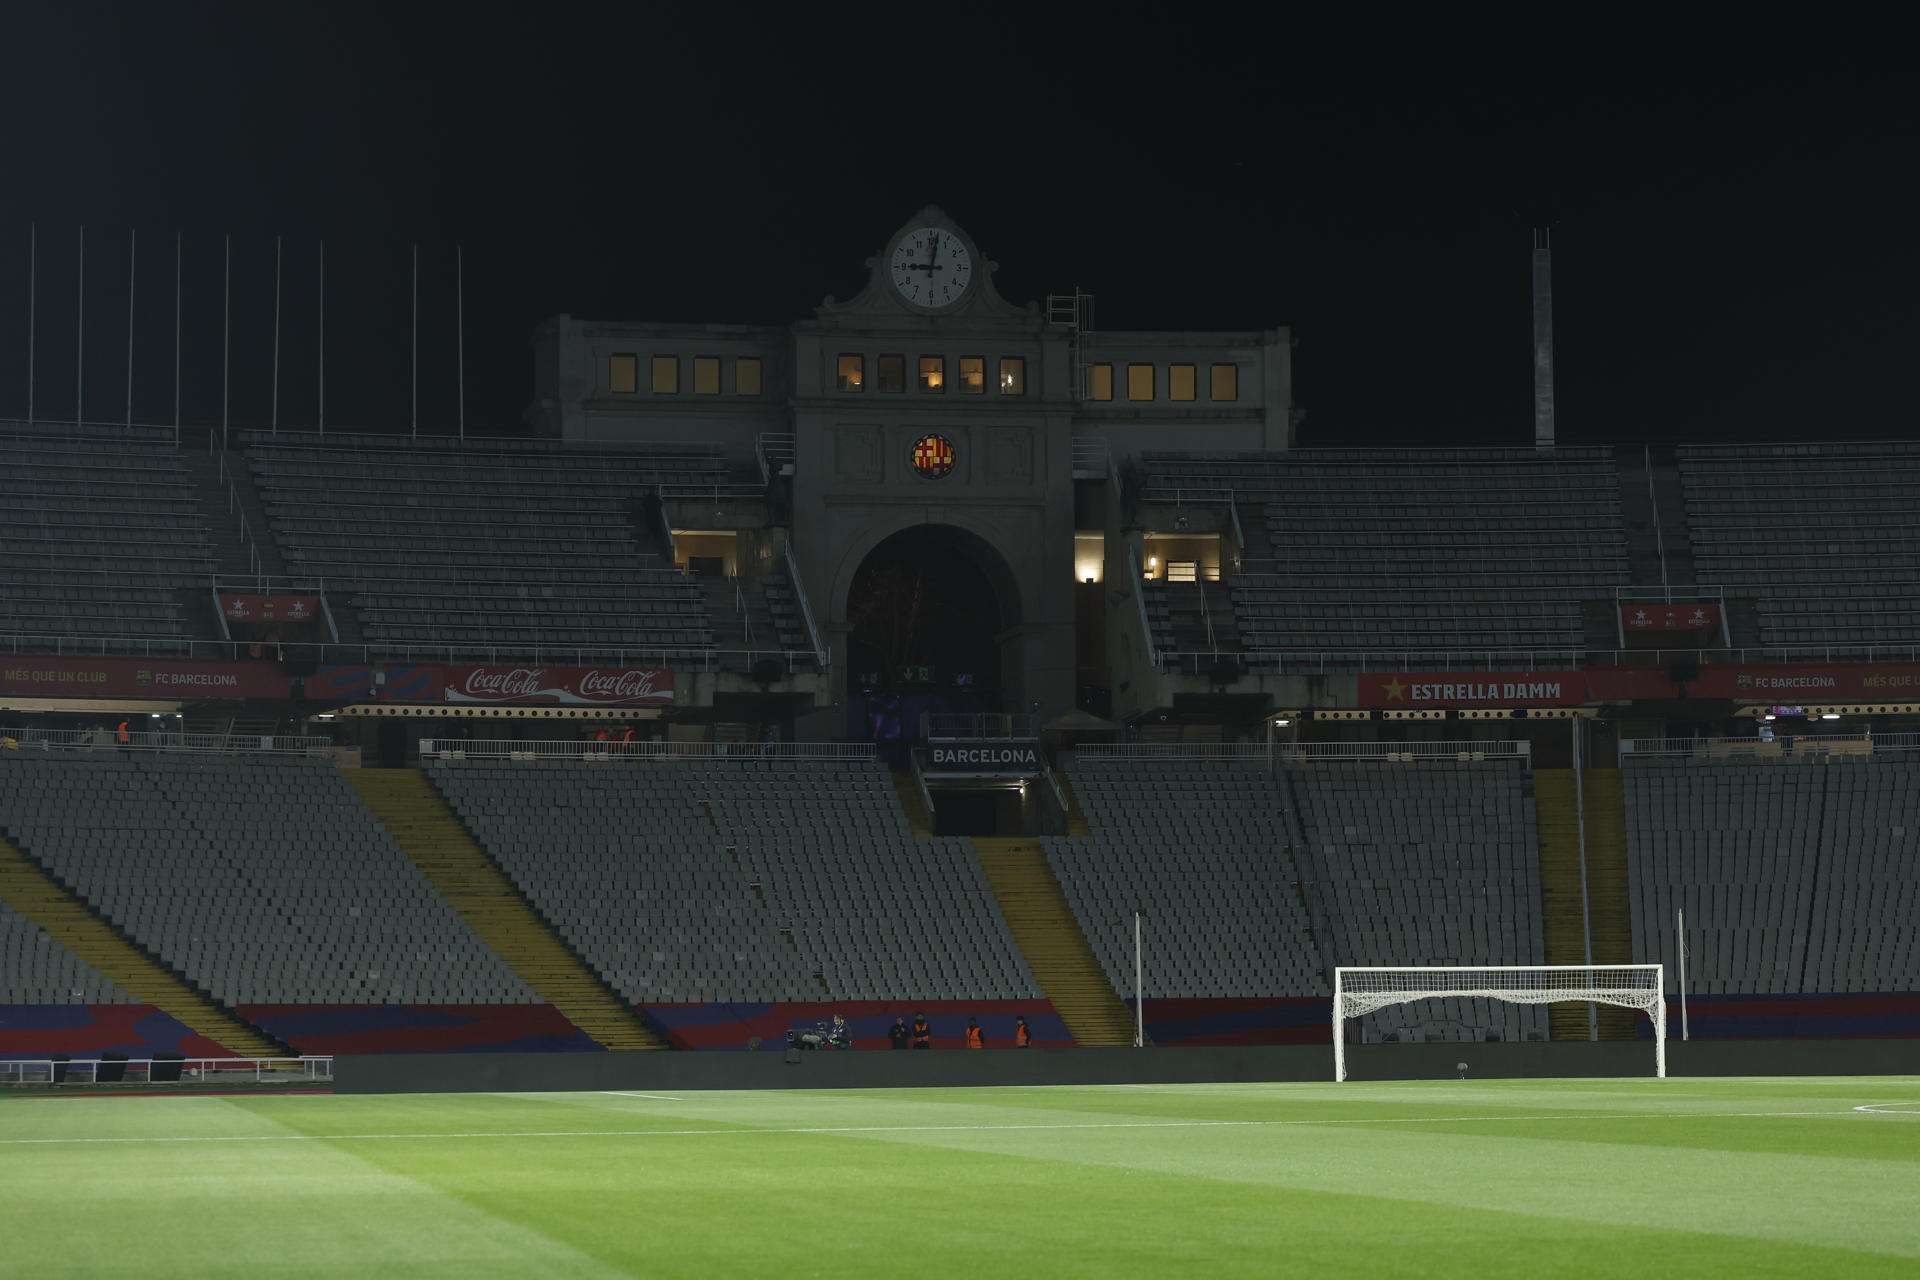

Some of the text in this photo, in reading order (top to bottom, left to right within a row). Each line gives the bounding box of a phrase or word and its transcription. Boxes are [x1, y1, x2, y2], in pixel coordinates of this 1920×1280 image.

[916, 241, 922, 249] 11
[907, 248, 914, 257] 10
[952, 249, 957, 258] 2
[901, 262, 907, 271] 9
[956, 263, 962, 272] 3
[905, 276, 911, 285] 8
[952, 278, 957, 286] 4
[913, 285, 919, 295] 7
[929, 290, 934, 299] 6
[32, 670, 56, 683] QUE
[58, 671, 74, 681] UN
[77, 671, 107, 682] CLUB
[155, 673, 238, 685] FC BARCELONA
[1755, 677, 1836, 688] FC BARCELONA
[1889, 675, 1912, 688] QUE
[1914, 675, 1920, 686] U
[1411, 682, 1561, 700] ESTRELLA DAMM
[933, 749, 1036, 763] BARCELONA
